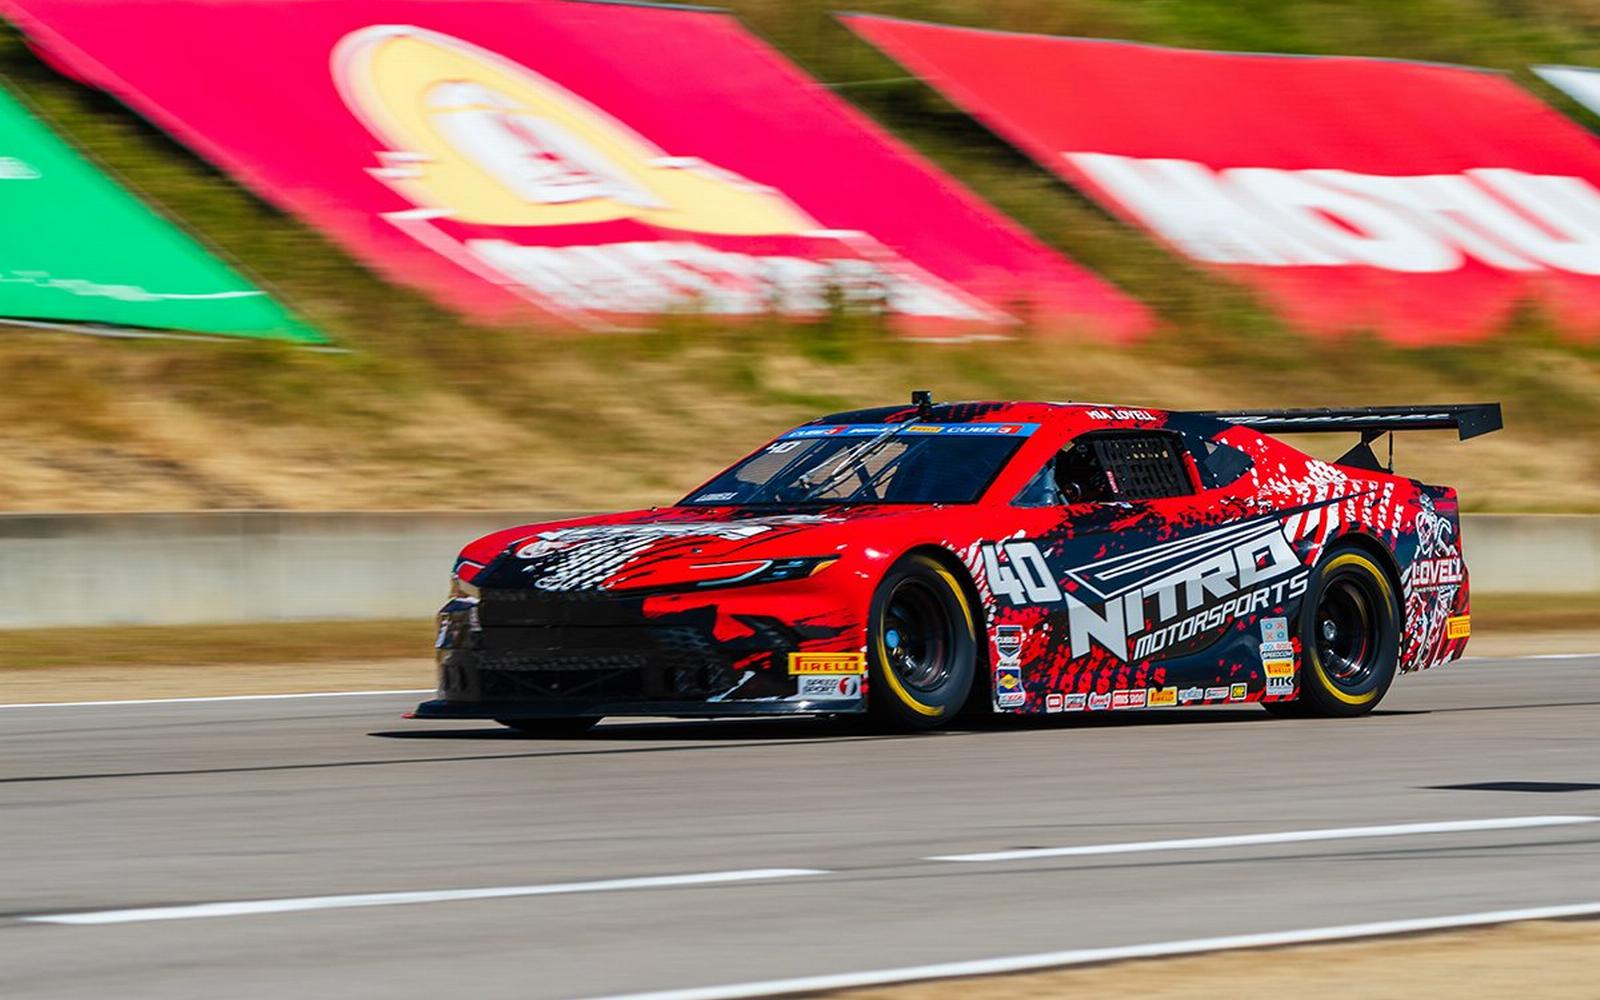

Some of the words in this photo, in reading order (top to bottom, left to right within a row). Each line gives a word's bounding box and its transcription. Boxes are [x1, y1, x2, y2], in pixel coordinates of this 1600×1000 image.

[982, 542, 1061, 604] 40
[1065, 529, 1301, 662] NITRO
[1412, 558, 1462, 586] LOVELL
[1132, 570, 1310, 660] MOTORSPORTS
[795, 656, 858, 671] PIRELLI
